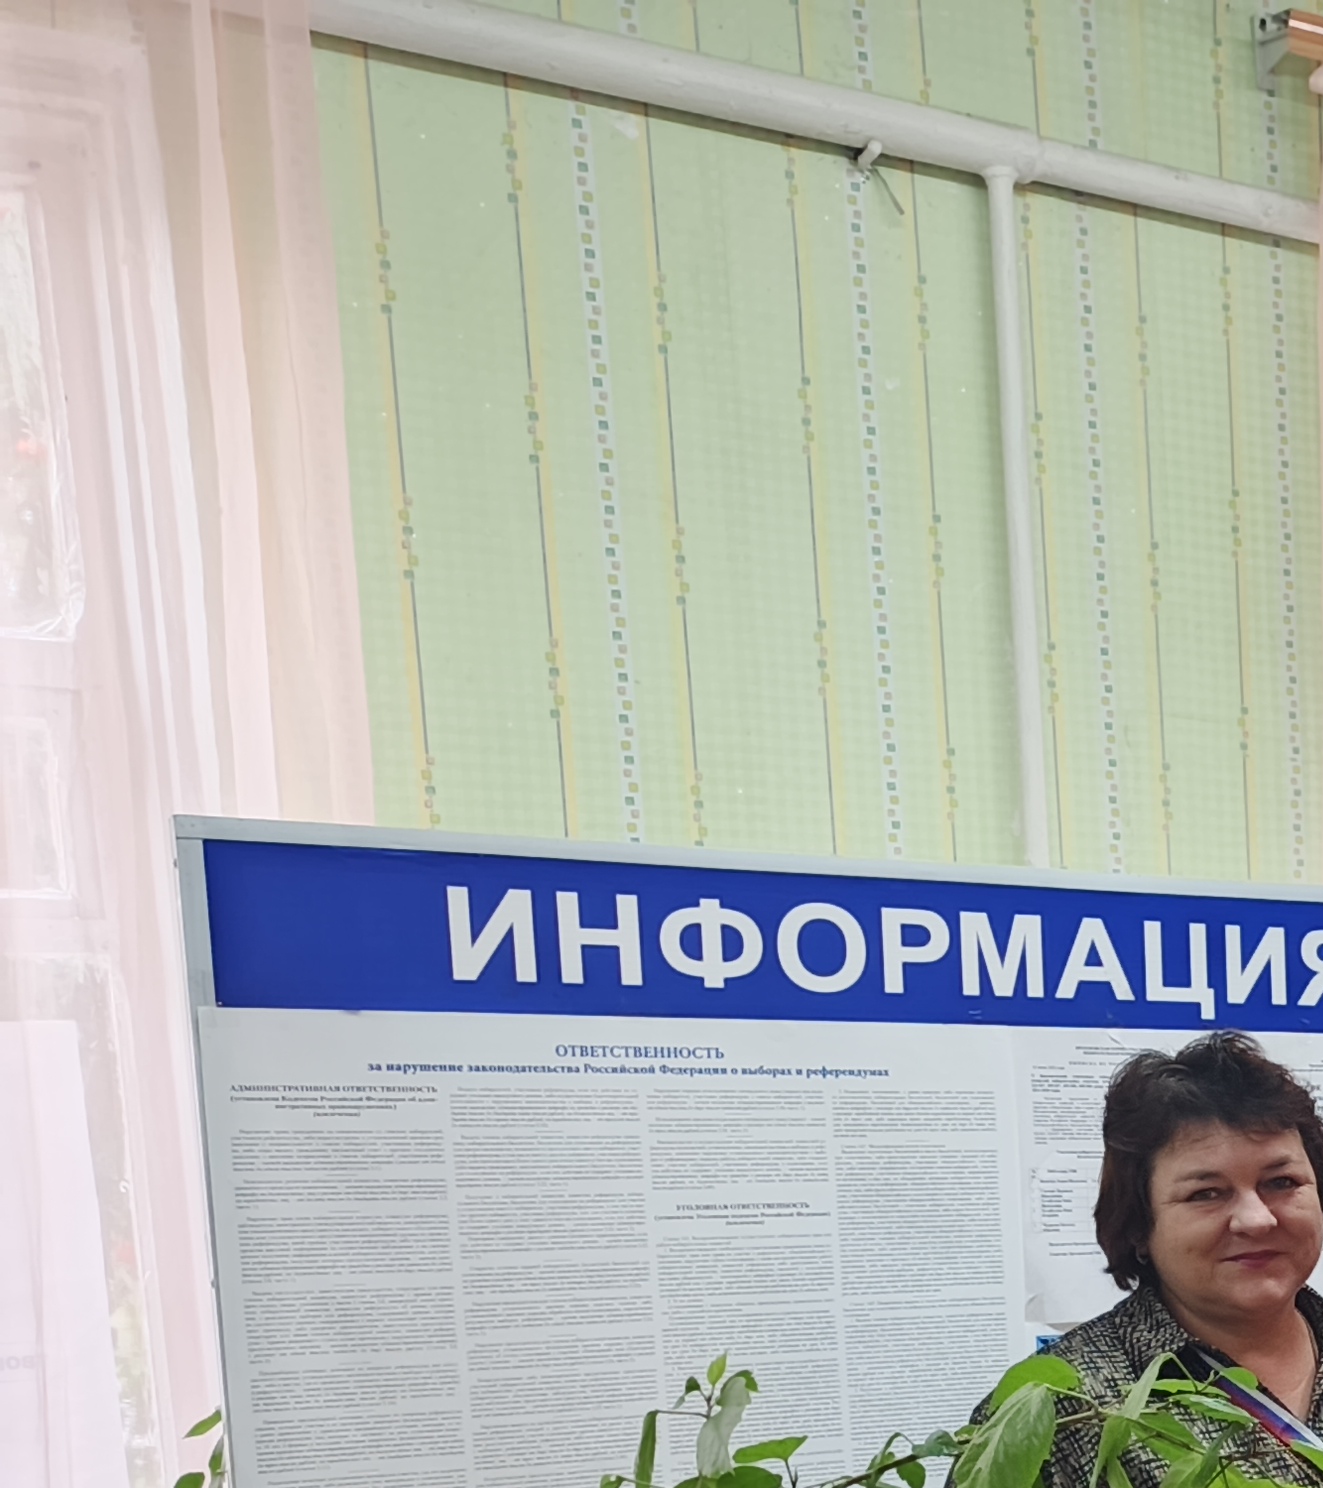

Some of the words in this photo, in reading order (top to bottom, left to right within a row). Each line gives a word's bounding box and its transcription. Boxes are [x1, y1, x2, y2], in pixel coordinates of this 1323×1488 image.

[555, 1044, 725, 1060] ОТВЕТСТВЕННОСТЬ
[367, 1063, 382, 1072] за
[385, 1063, 463, 1075] нарушение
[467, 1064, 580, 1076] законодательства
[584, 1063, 656, 1075] Российской
[660, 1064, 727, 1077] Федерации
[741, 1066, 792, 1077] выборах
[806, 1066, 889, 1079] референдумах
